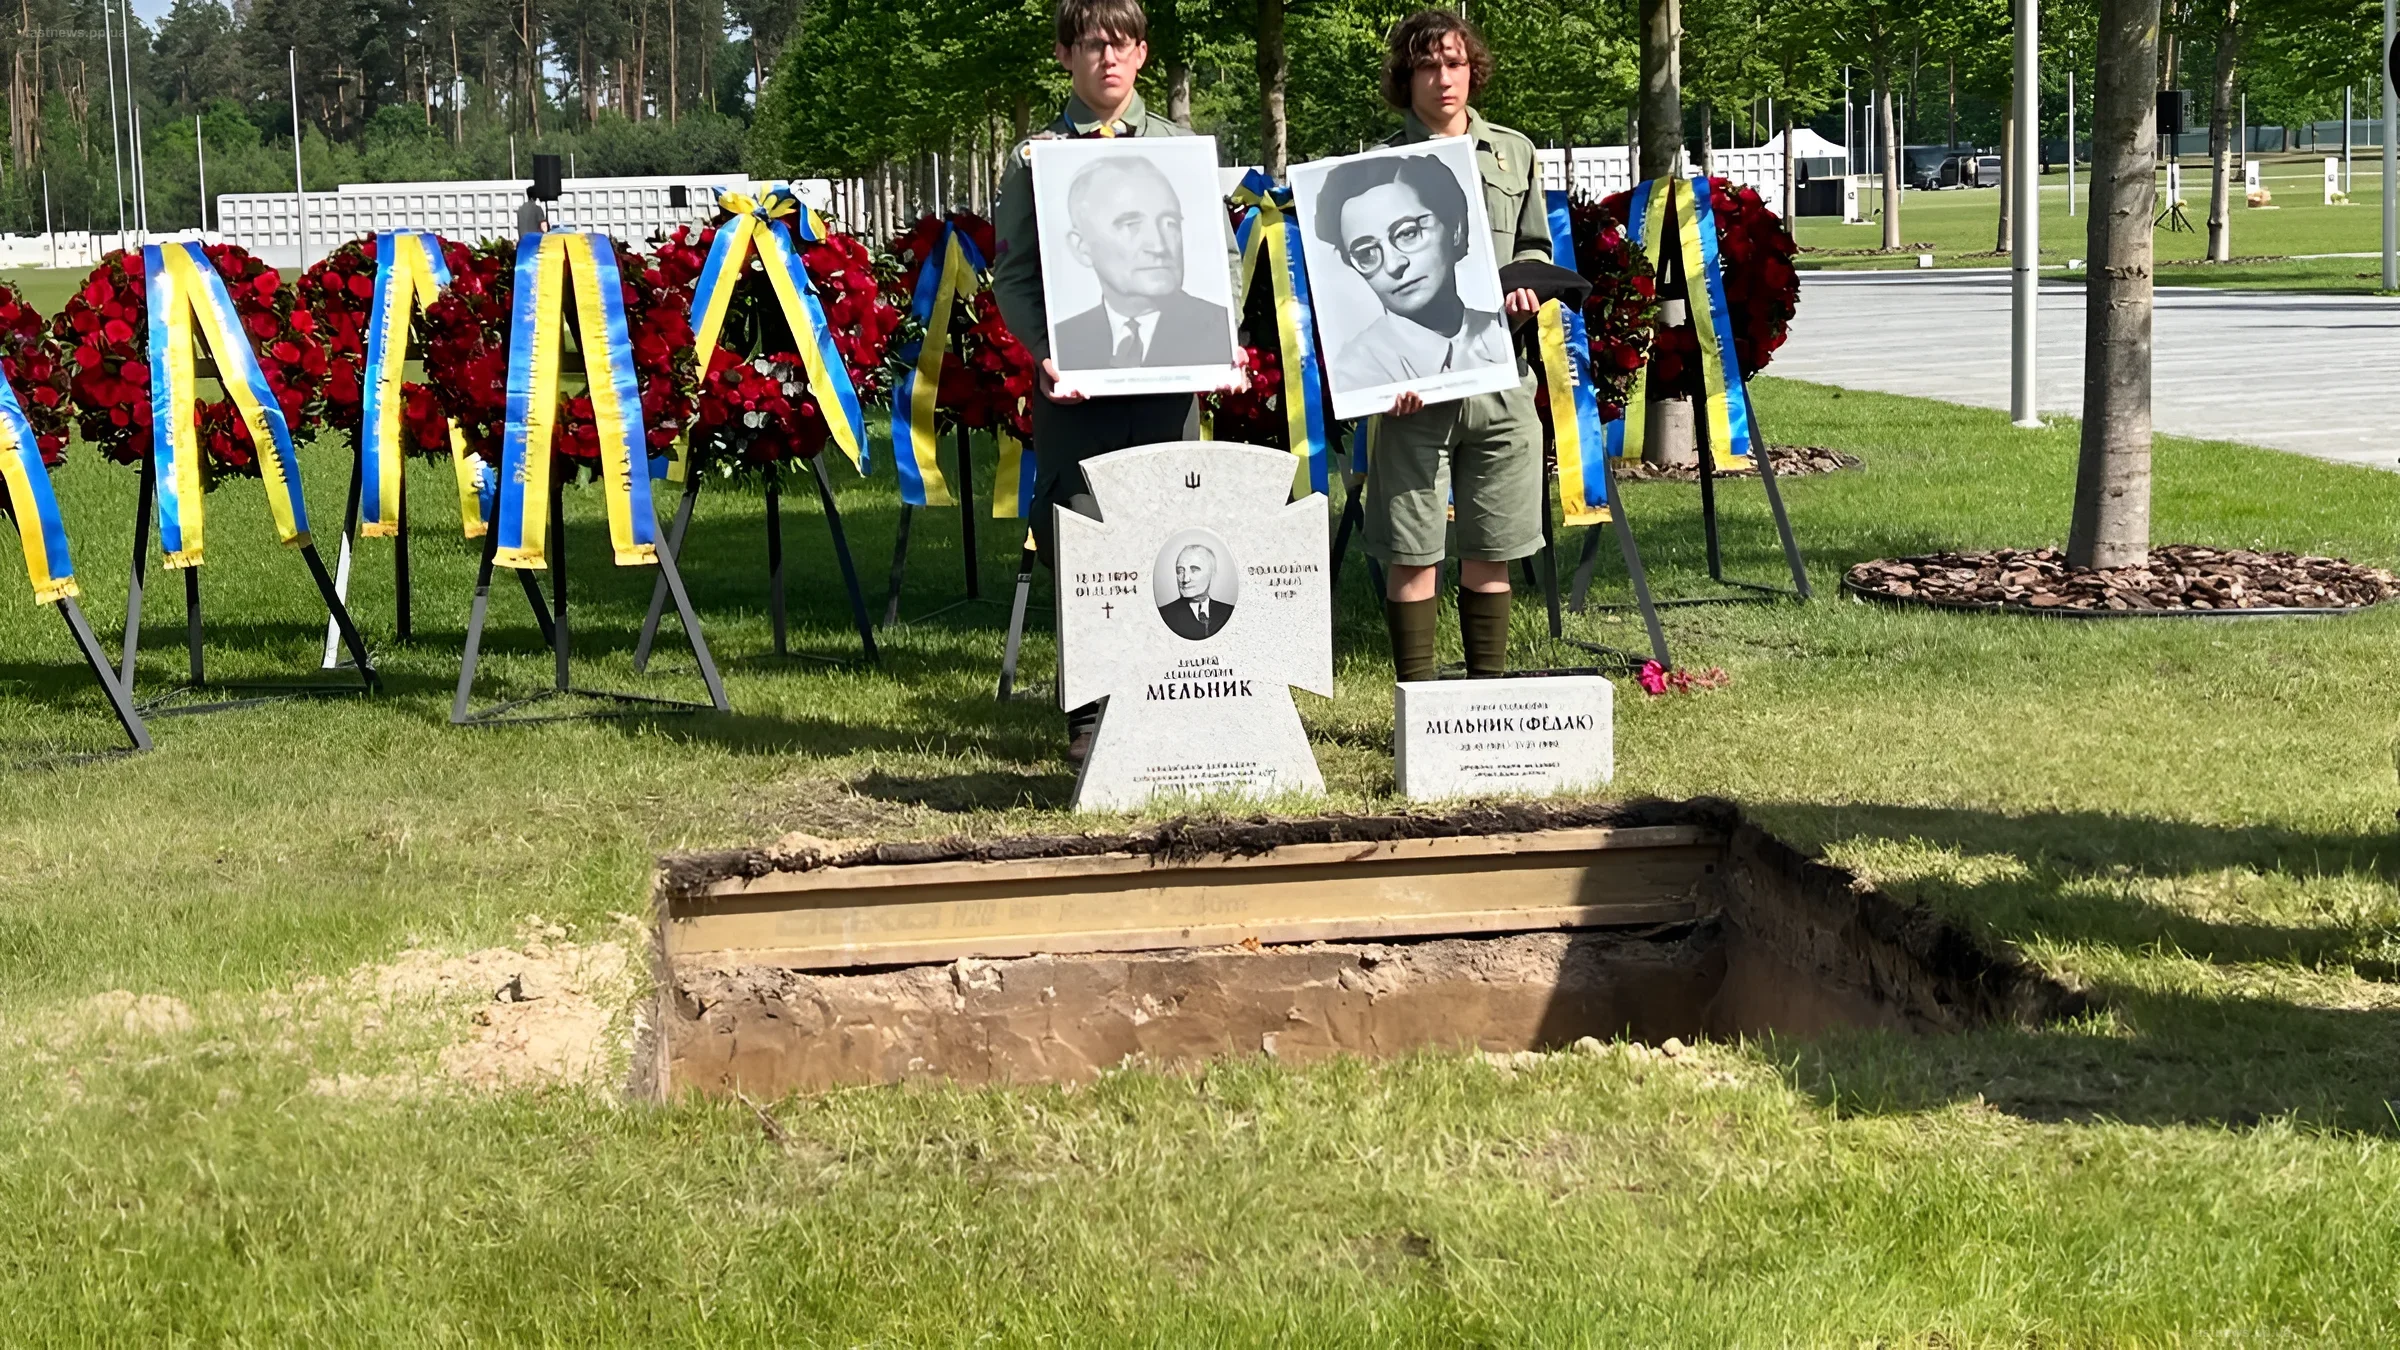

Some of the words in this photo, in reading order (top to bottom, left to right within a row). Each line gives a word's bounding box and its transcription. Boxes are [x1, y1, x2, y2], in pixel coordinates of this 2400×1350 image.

[1146, 680, 1252, 701] МЕЛЬНИК
[1426, 717, 1514, 734] МЕЛЬНИК
[1519, 714, 1594, 733] (ФЕДАК)
